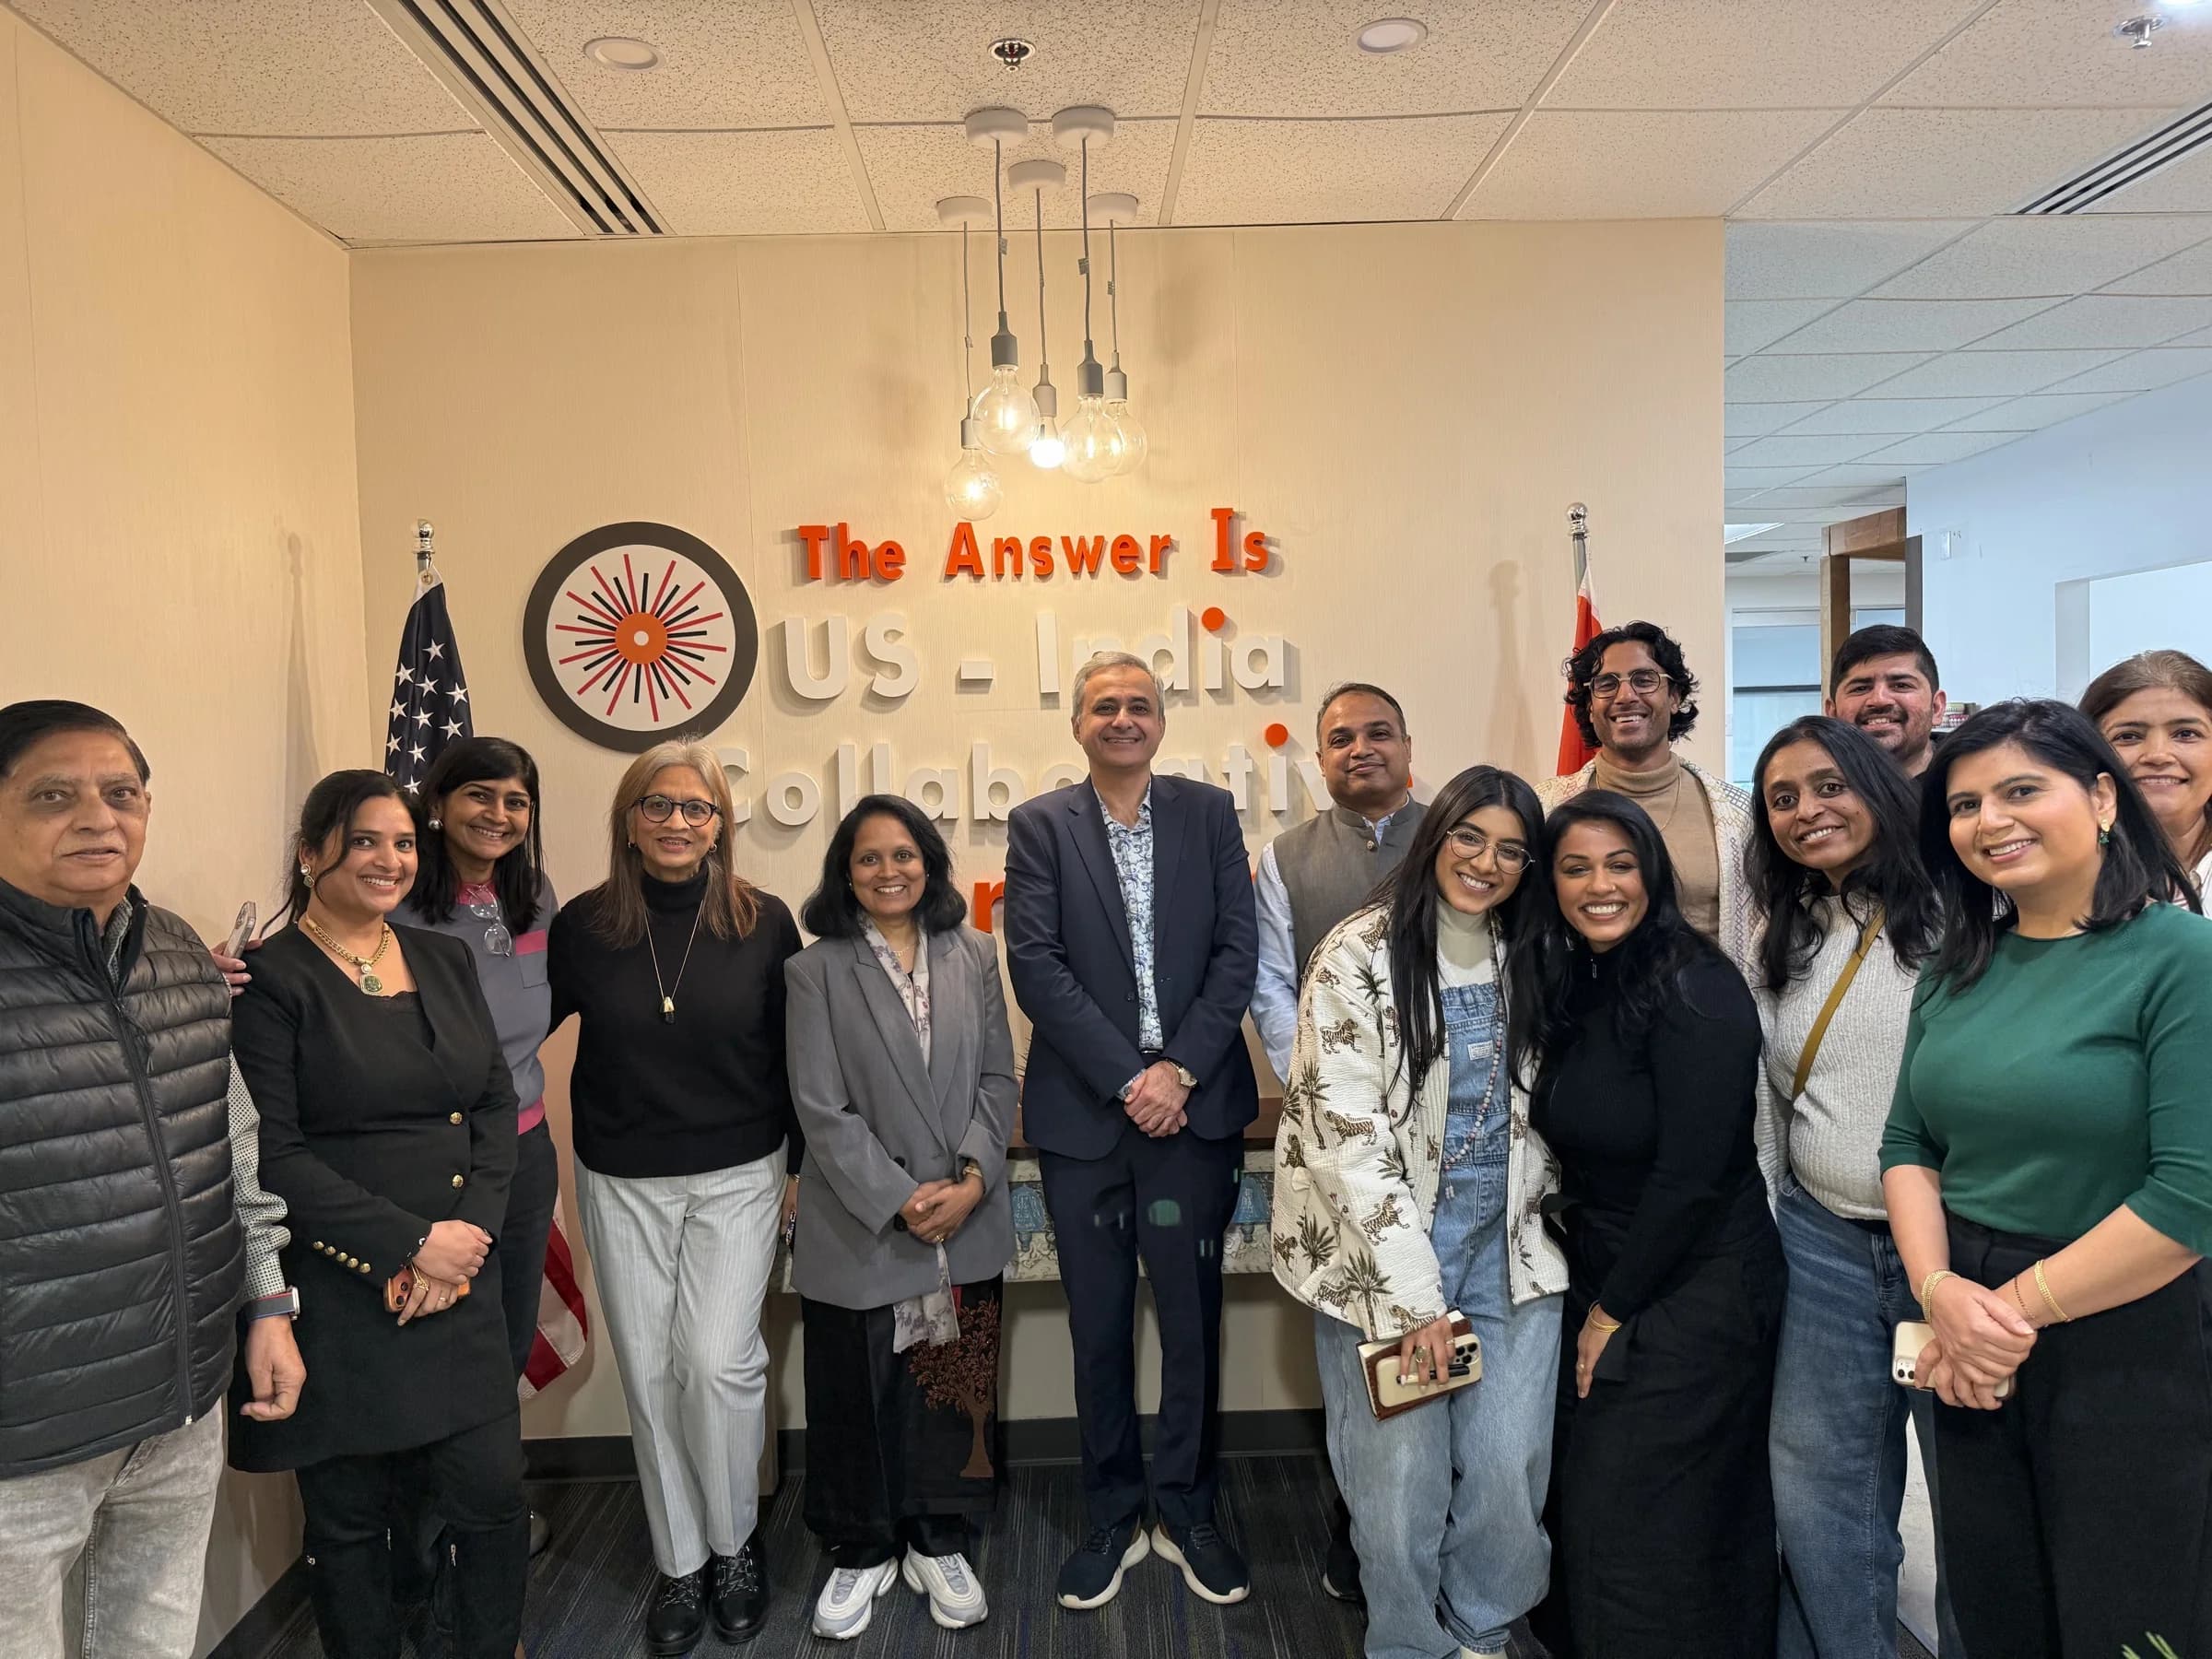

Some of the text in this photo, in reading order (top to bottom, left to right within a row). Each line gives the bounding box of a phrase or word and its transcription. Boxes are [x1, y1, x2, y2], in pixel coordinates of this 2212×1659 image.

[798, 507, 1271, 581] The Answer Is
[783, 612, 921, 700] US
